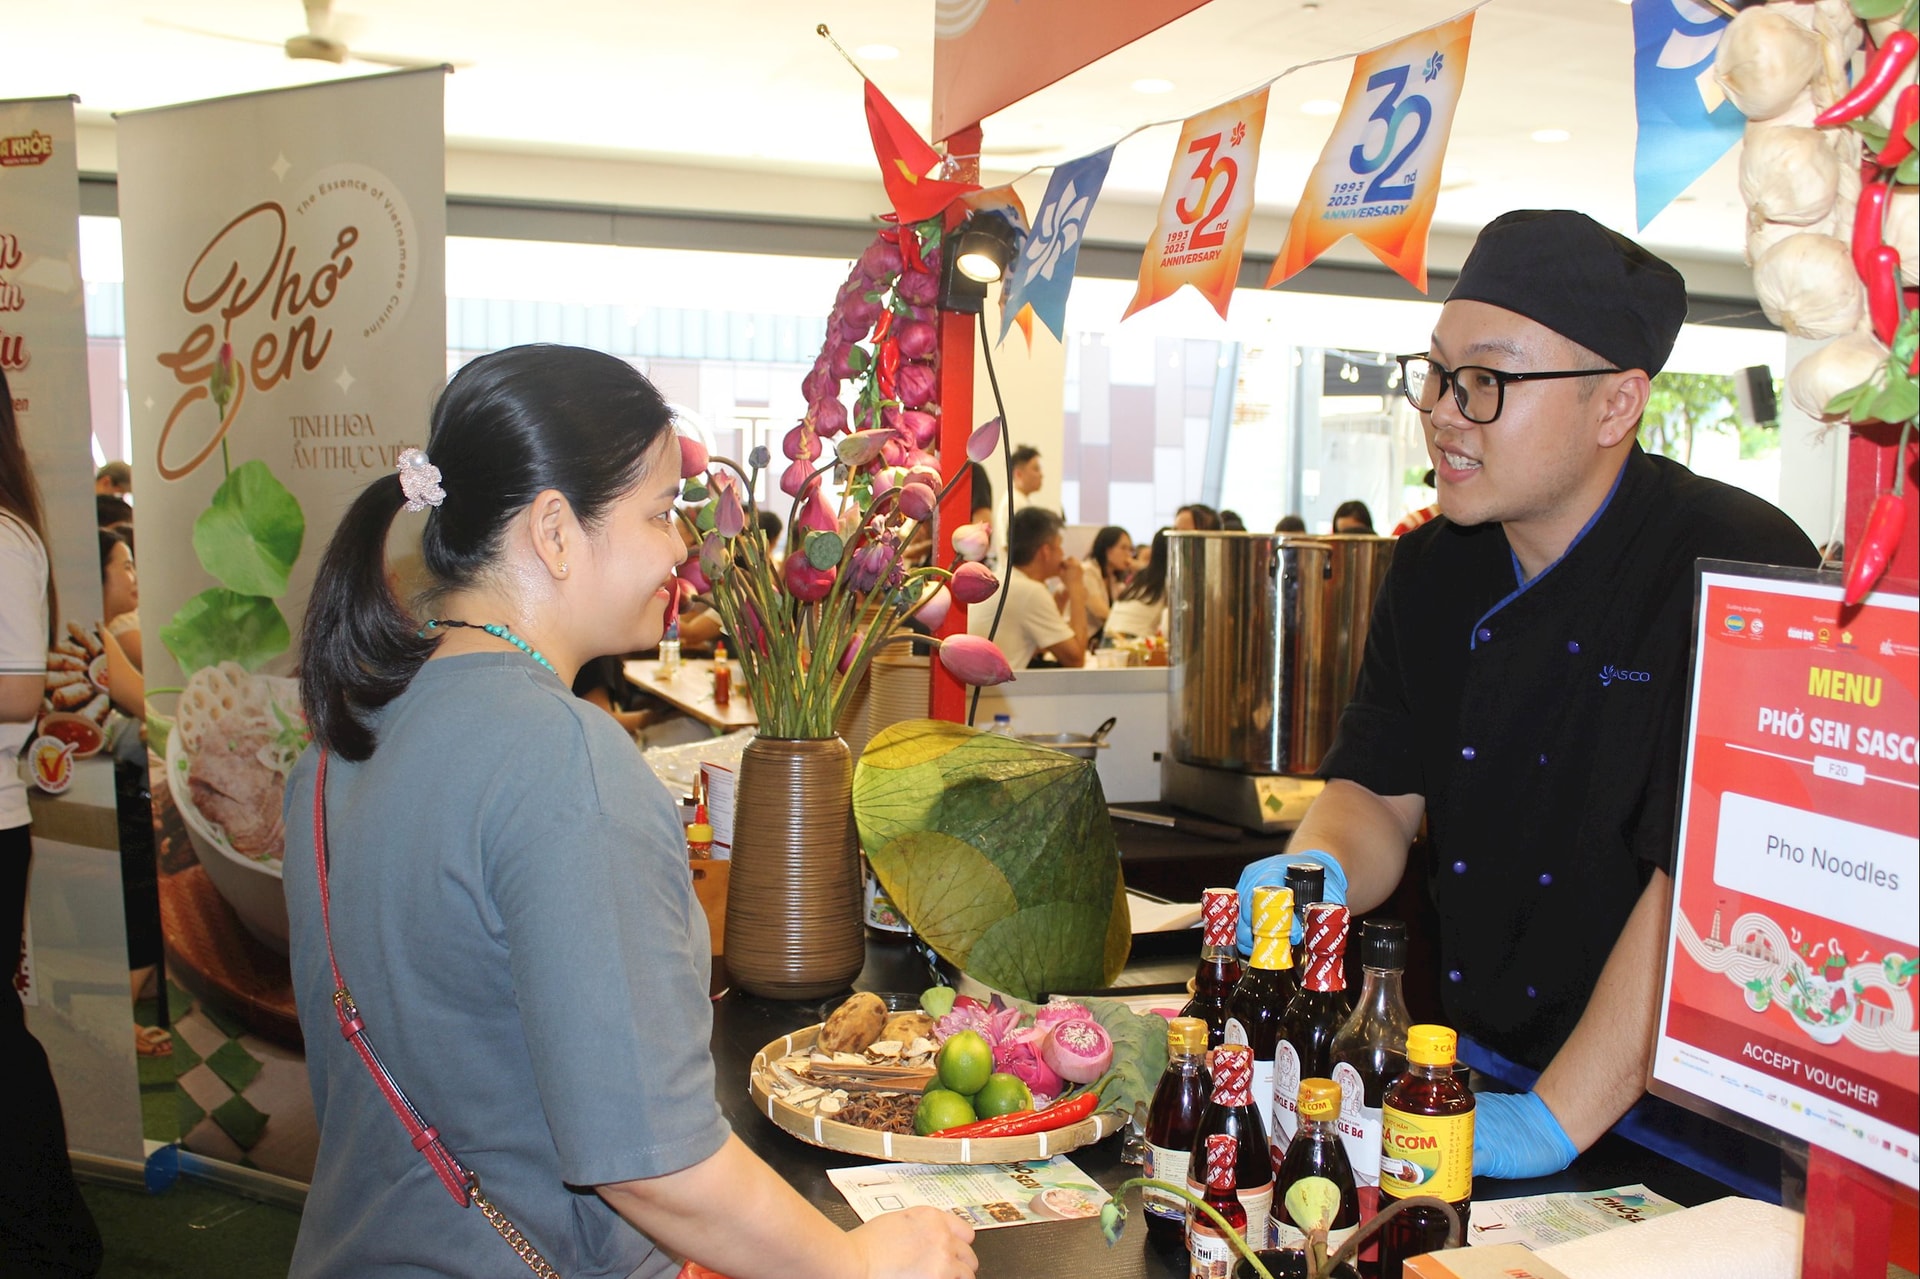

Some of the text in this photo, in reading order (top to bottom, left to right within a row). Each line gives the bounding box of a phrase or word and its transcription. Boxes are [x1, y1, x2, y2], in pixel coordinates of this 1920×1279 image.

[1333, 181, 1365, 194] 1993
[1327, 195, 1359, 207] 2025
[1321, 205, 1409, 220] ANNIVERSARY
[1167, 230, 1189, 242] 1993
[1163, 243, 1185, 255] 2025
[296, 179, 407, 338] The Essence of Vietnamese Cuisine
[1160, 249, 1221, 268] ANNIVERSARY
[289, 415, 330, 438] TINH
[1808, 666, 1882, 708] MENU
[1758, 707, 1805, 740] PHỞ
[1809, 717, 1850, 750] SEN
[1828, 763, 1849, 778] F20
[1766, 834, 1899, 892] Pho Noodles
[1742, 1041, 1801, 1075] ACCEPT
[1804, 1063, 1879, 1108] VOUCHER
[1351, 1126, 1364, 1139] BA
[1395, 1134, 1438, 1150] CƠM
